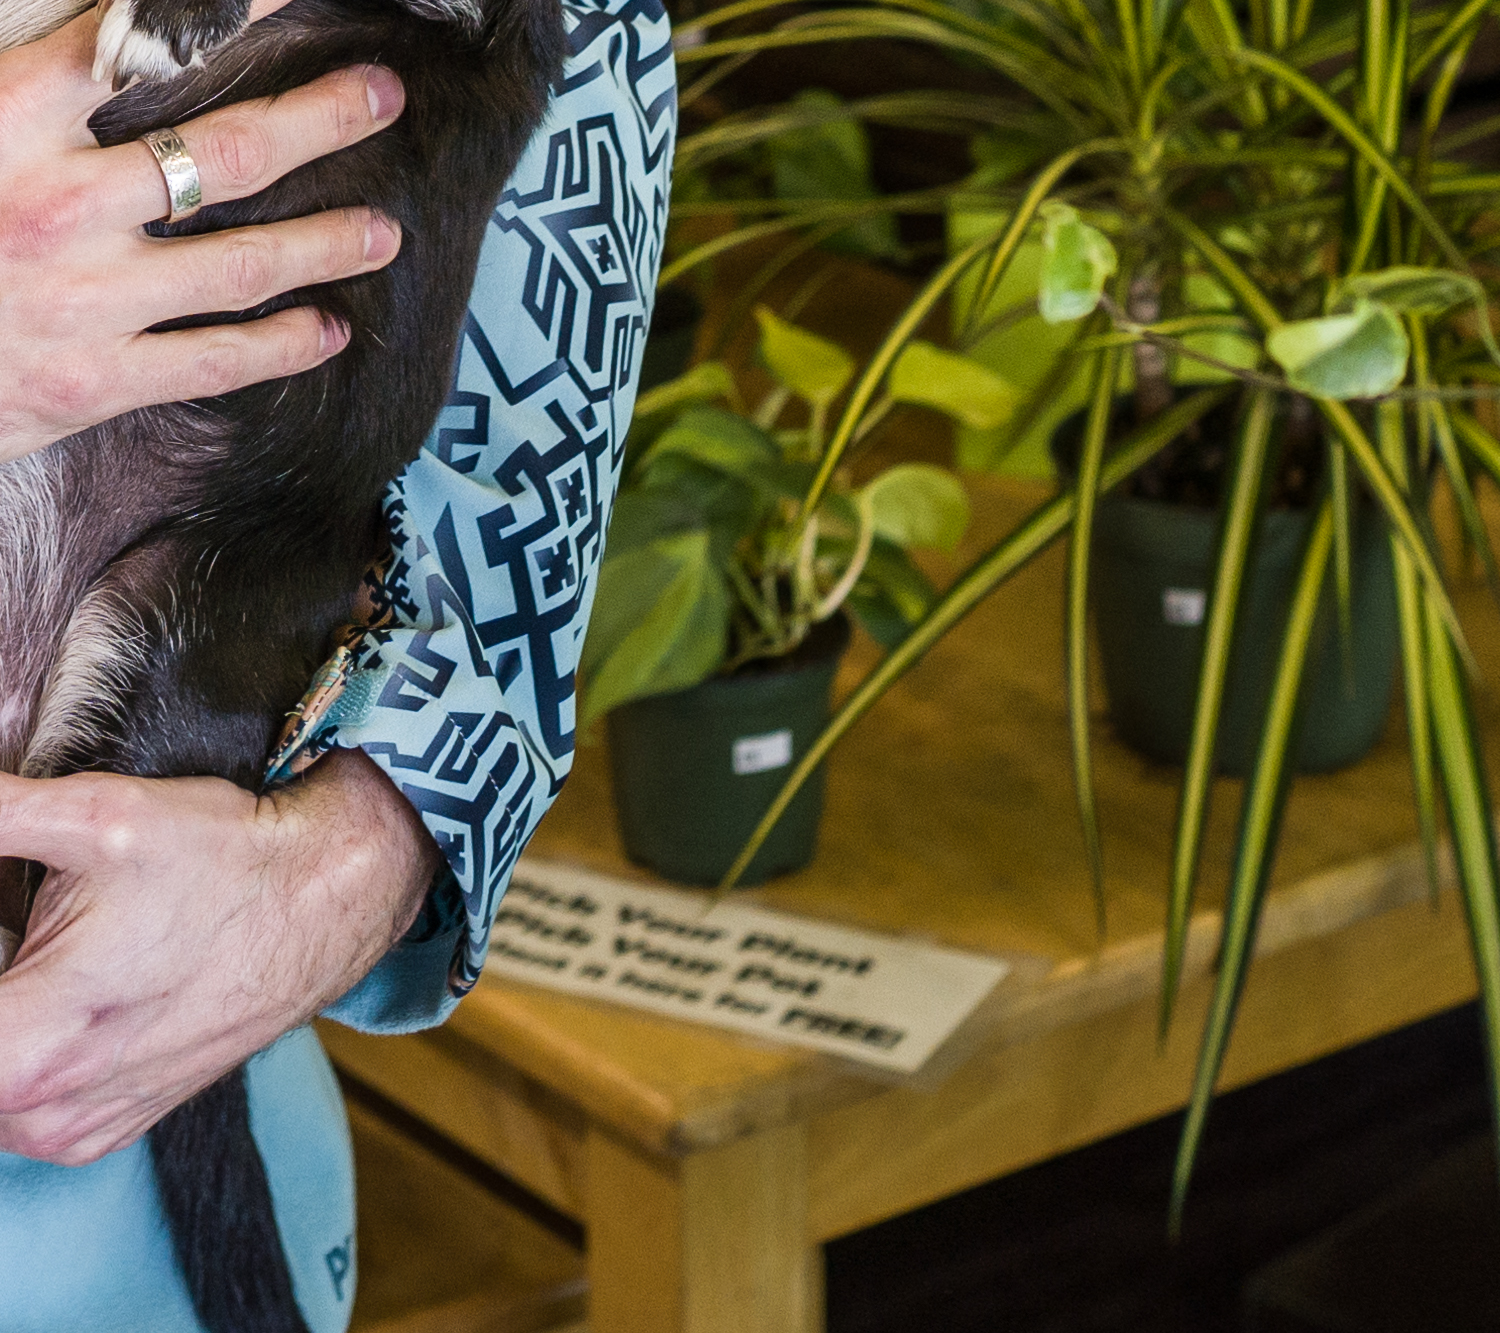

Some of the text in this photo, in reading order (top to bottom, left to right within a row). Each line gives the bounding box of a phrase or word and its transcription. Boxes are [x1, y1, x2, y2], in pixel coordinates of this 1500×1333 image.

[613, 935, 722, 976] Your
[734, 962, 823, 1001] Pot
[618, 903, 722, 944] Your
[738, 931, 876, 978] Plant
